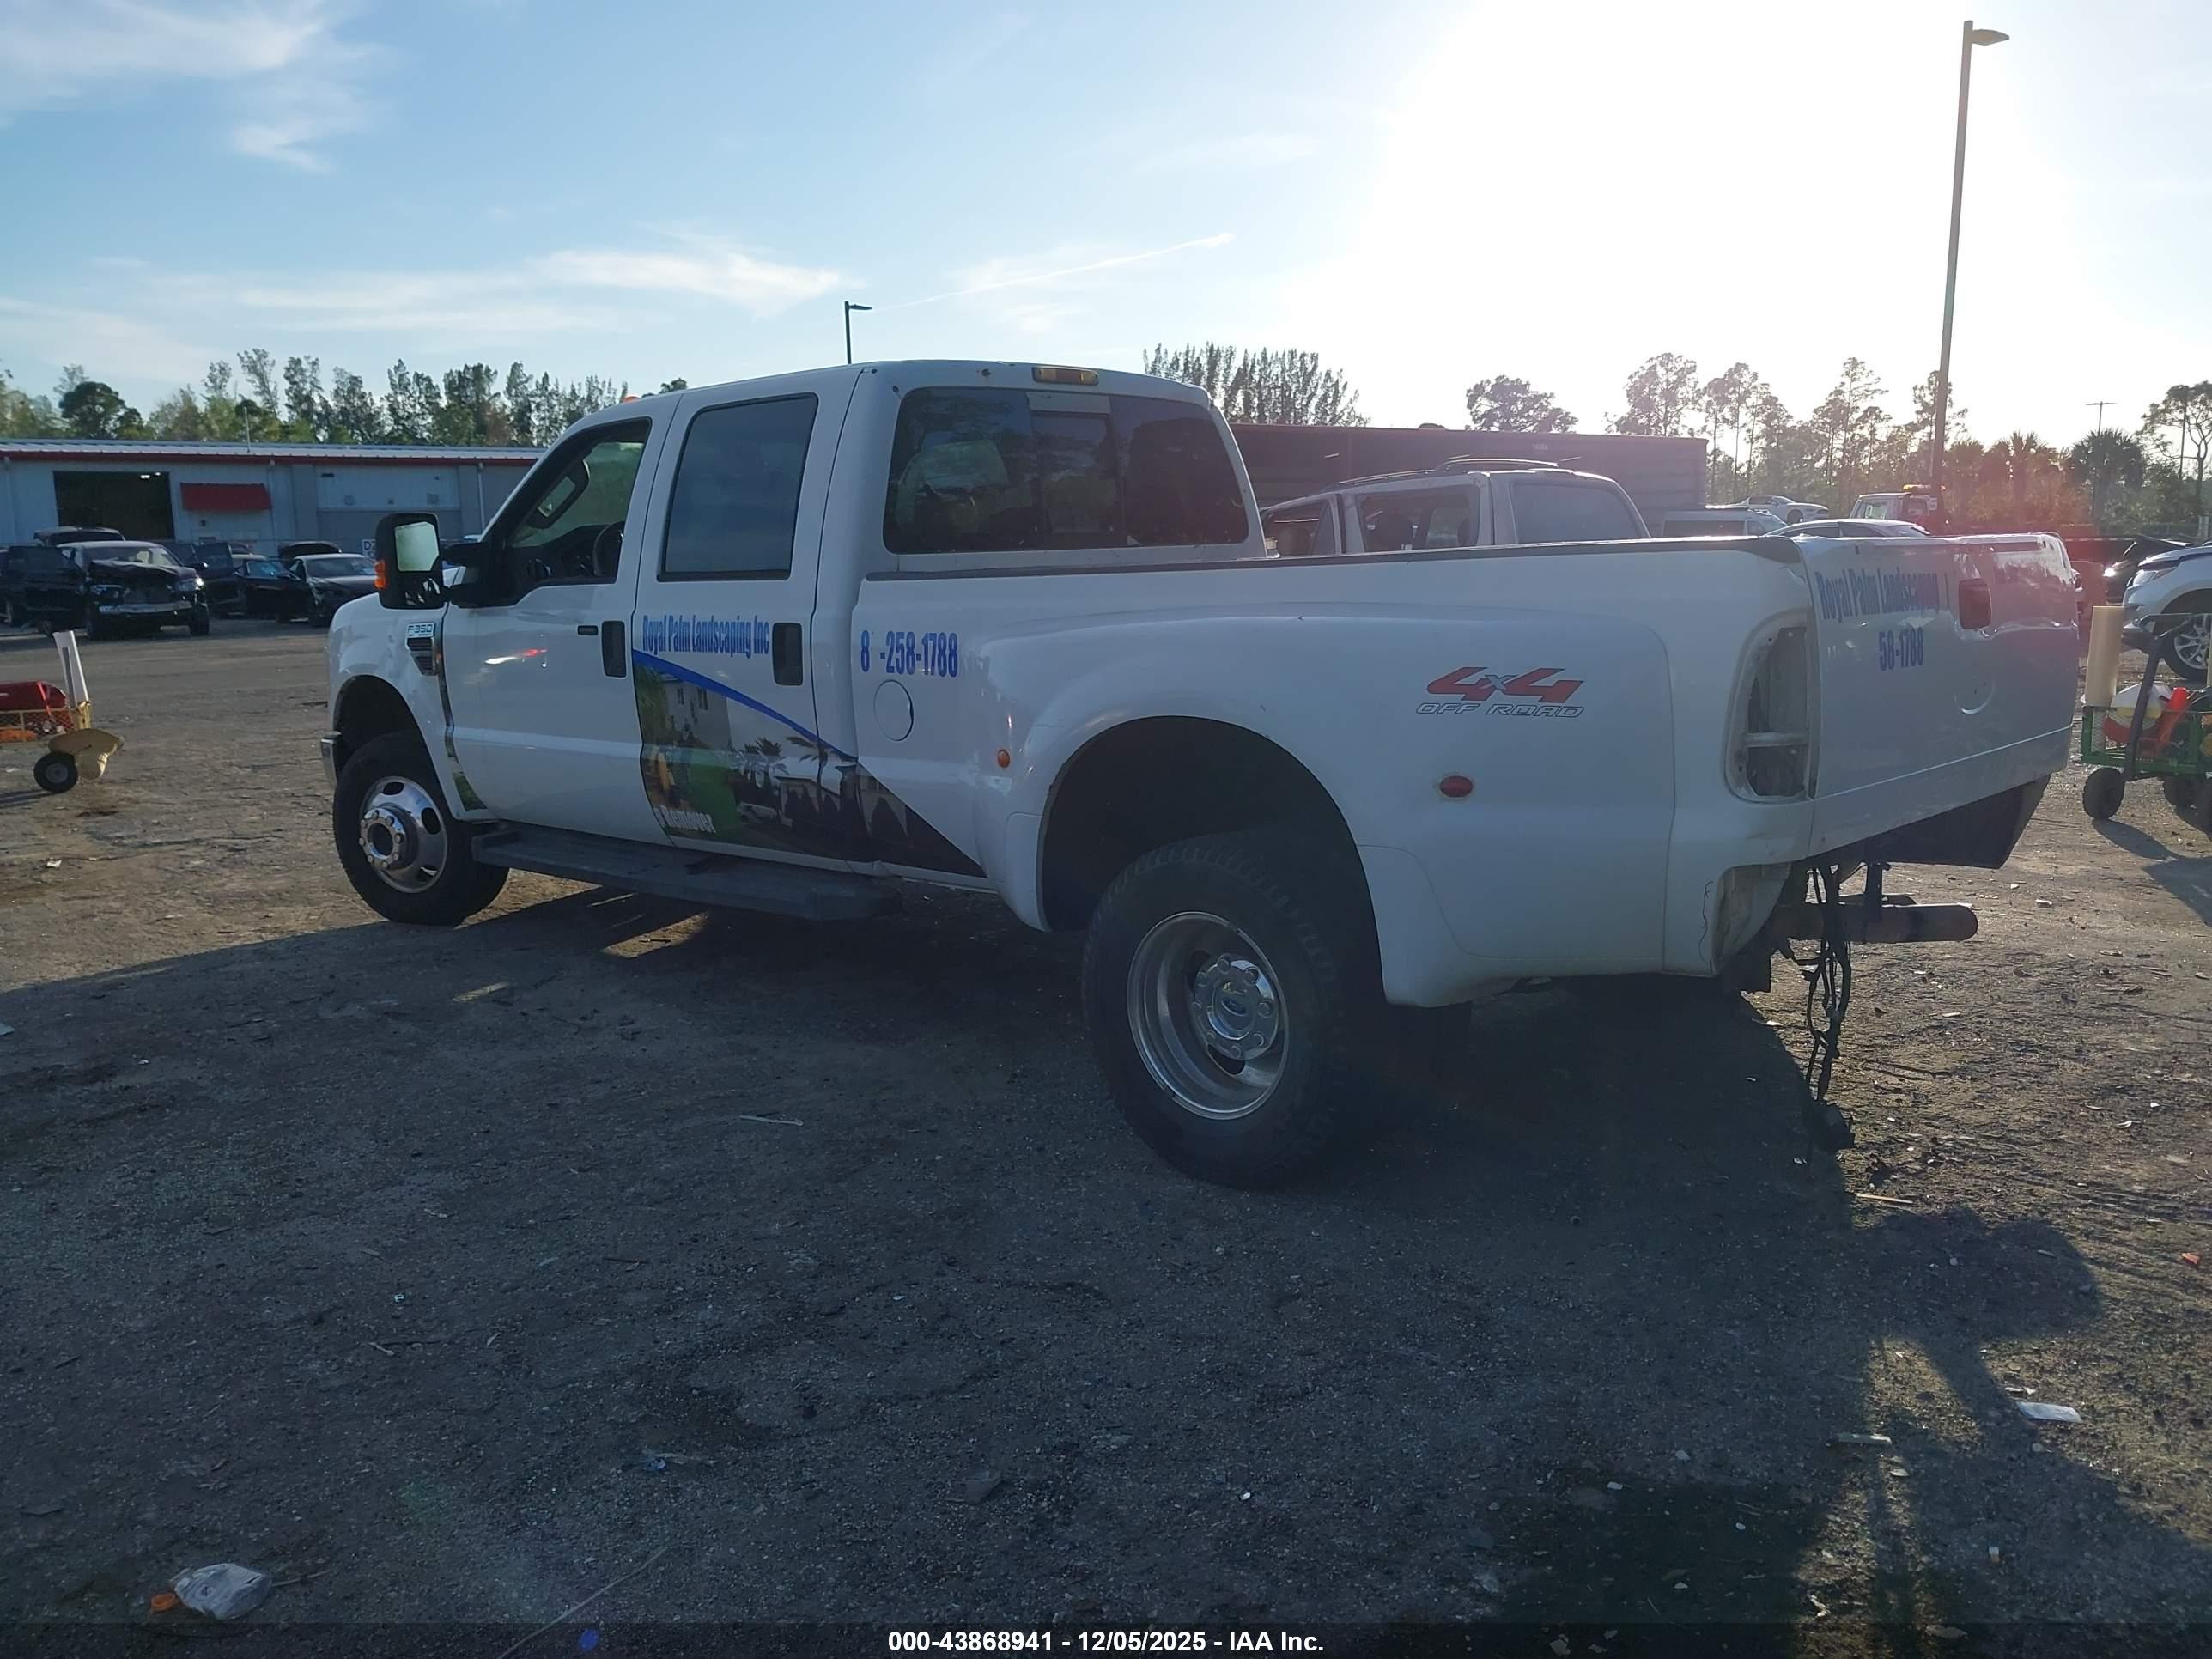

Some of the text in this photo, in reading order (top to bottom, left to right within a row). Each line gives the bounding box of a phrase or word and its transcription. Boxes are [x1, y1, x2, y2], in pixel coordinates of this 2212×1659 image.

[643, 615, 769, 659] Royal Palm Landscaping Inc
[1426, 666, 1584, 703] 4x4
[1416, 702, 1585, 718] OFF ROAD
